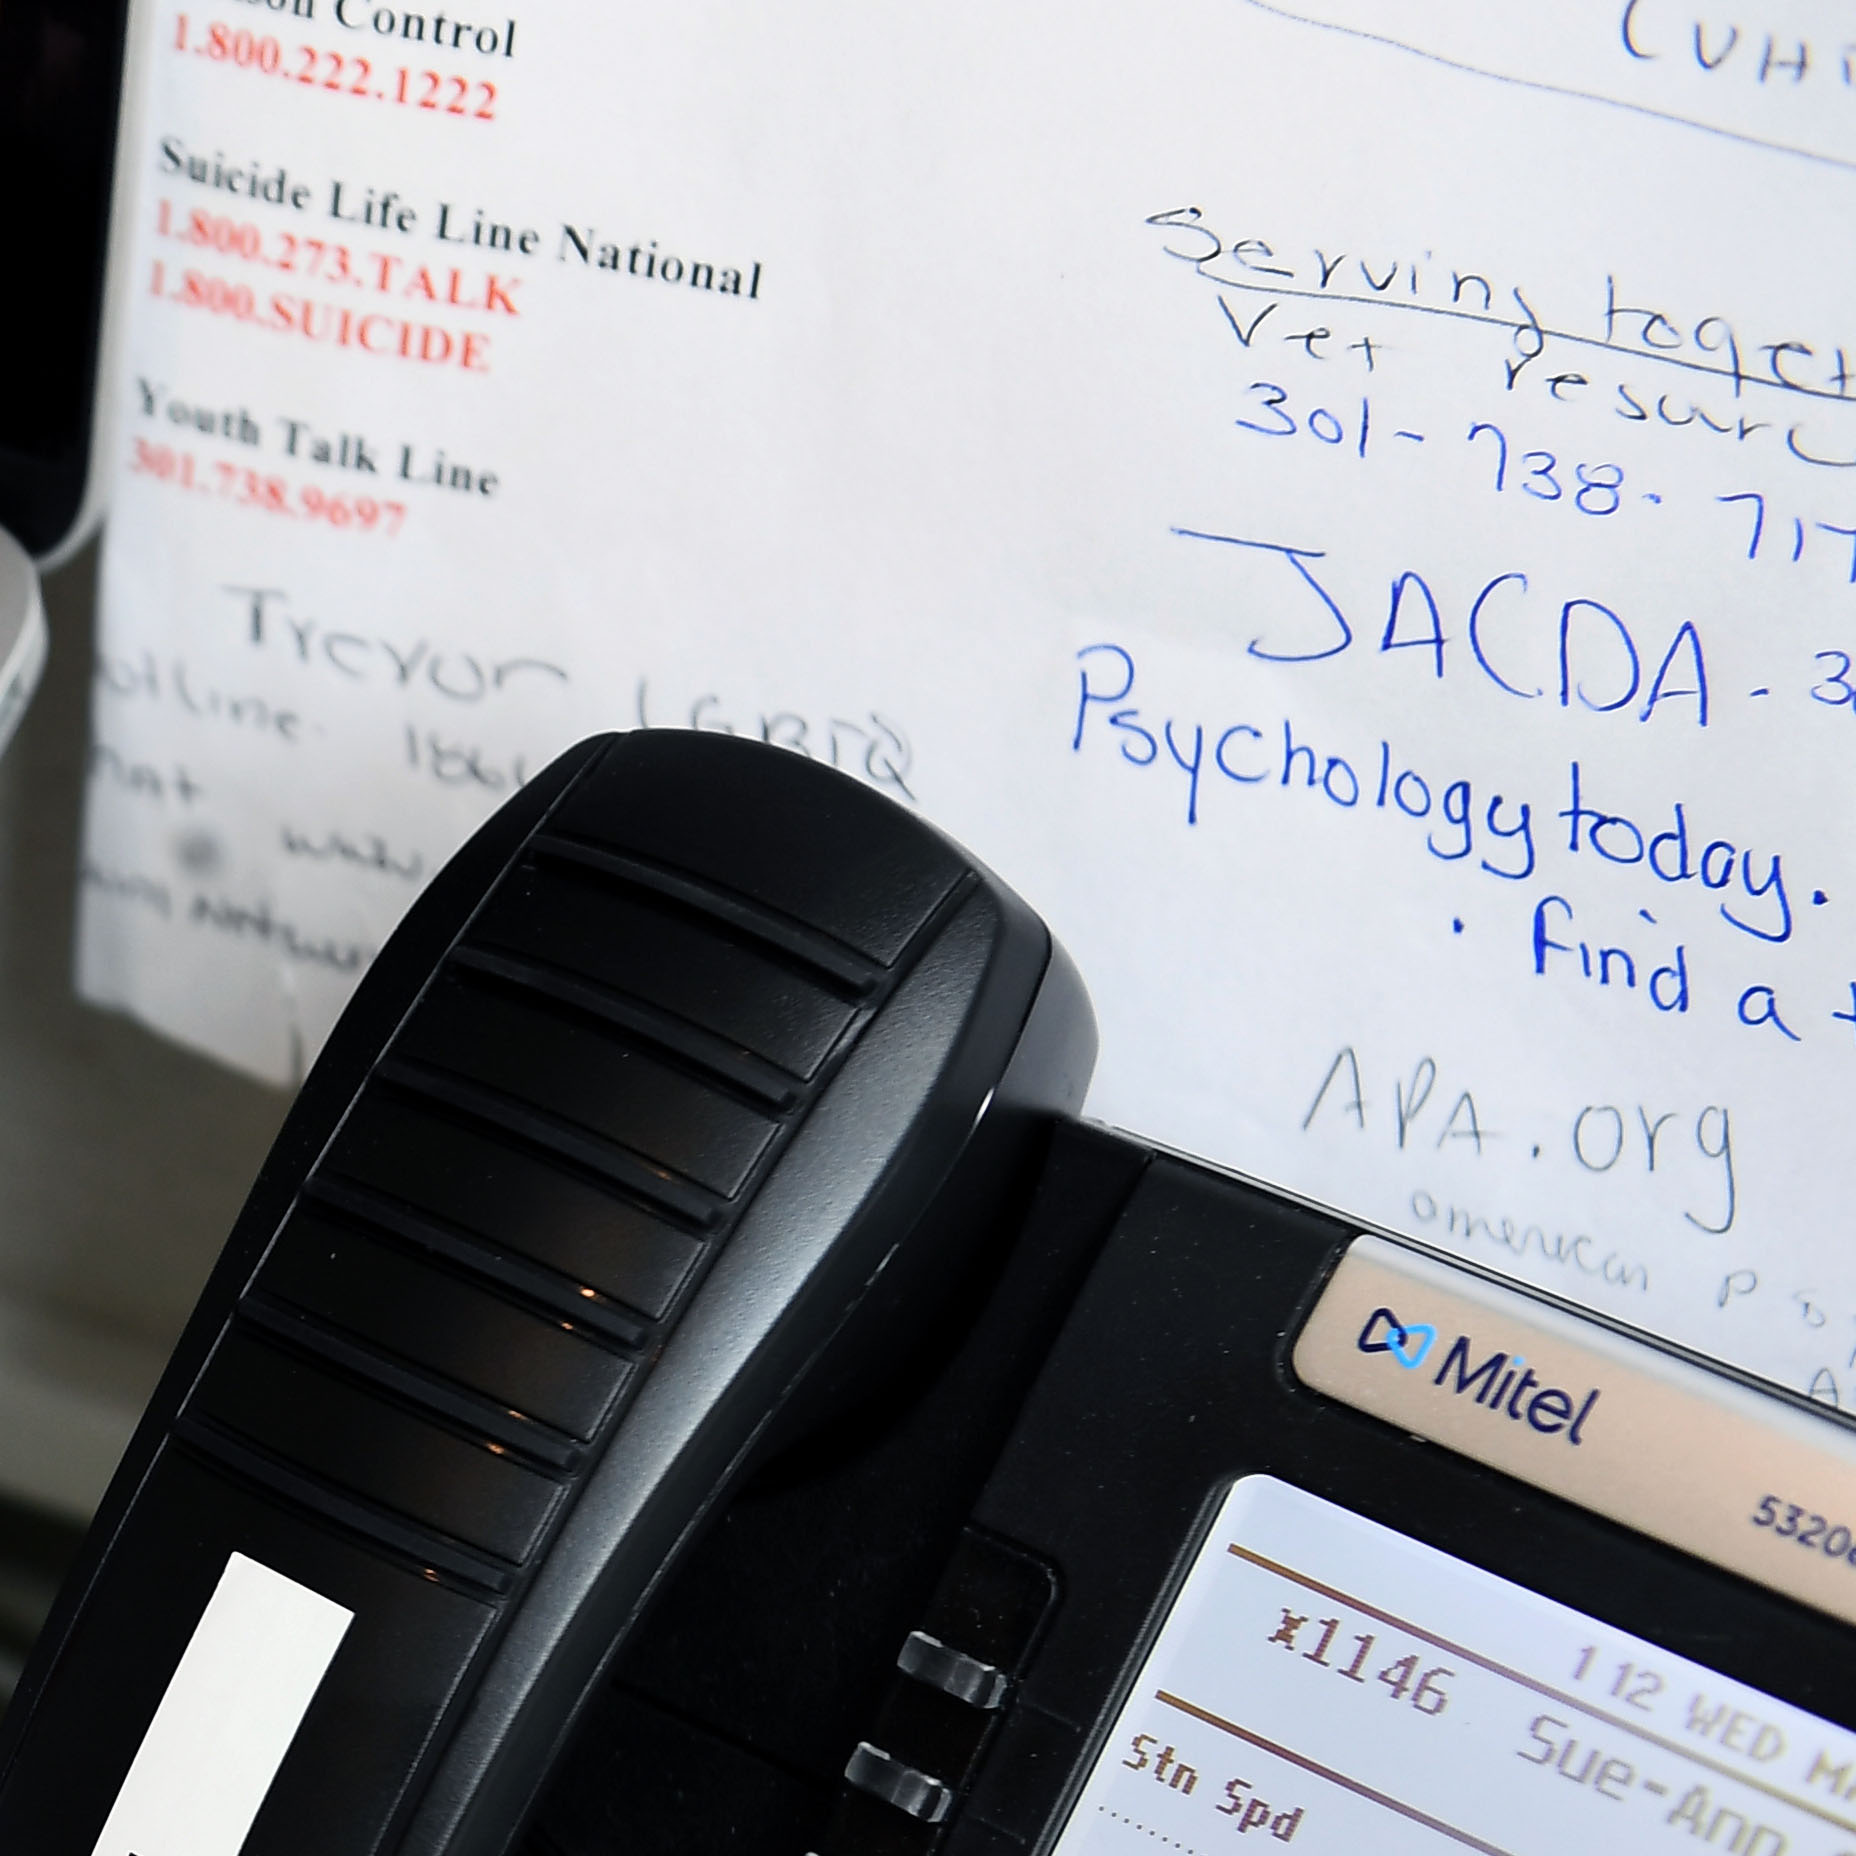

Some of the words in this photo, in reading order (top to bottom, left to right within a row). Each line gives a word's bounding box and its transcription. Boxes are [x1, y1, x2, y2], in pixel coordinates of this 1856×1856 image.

[174, 14, 498, 121] 1.800.222.1222
[335, 0, 517, 57] Control
[155, 199, 523, 317] 1.800.273.TALK
[159, 138, 310, 210] Suicide
[327, 182, 418, 236] Life
[436, 204, 539, 258] Line
[559, 224, 765, 300] National
[147, 261, 493, 373] 1.800.SUICIDE
[128, 438, 407, 540] 301.738.9697
[135, 378, 261, 448] Youth
[282, 420, 379, 476] Talk
[399, 443, 501, 498] Line
[218, 583, 570, 703] Trevor
[1534, 895, 1690, 1012] find
[1737, 985, 1802, 1042] a
[1433, 1335, 1601, 1446] Mitel
[1685, 1692, 1786, 1765] WED
[1121, 1733, 1199, 1796] Stn
[1215, 1777, 1306, 1845] Spd
